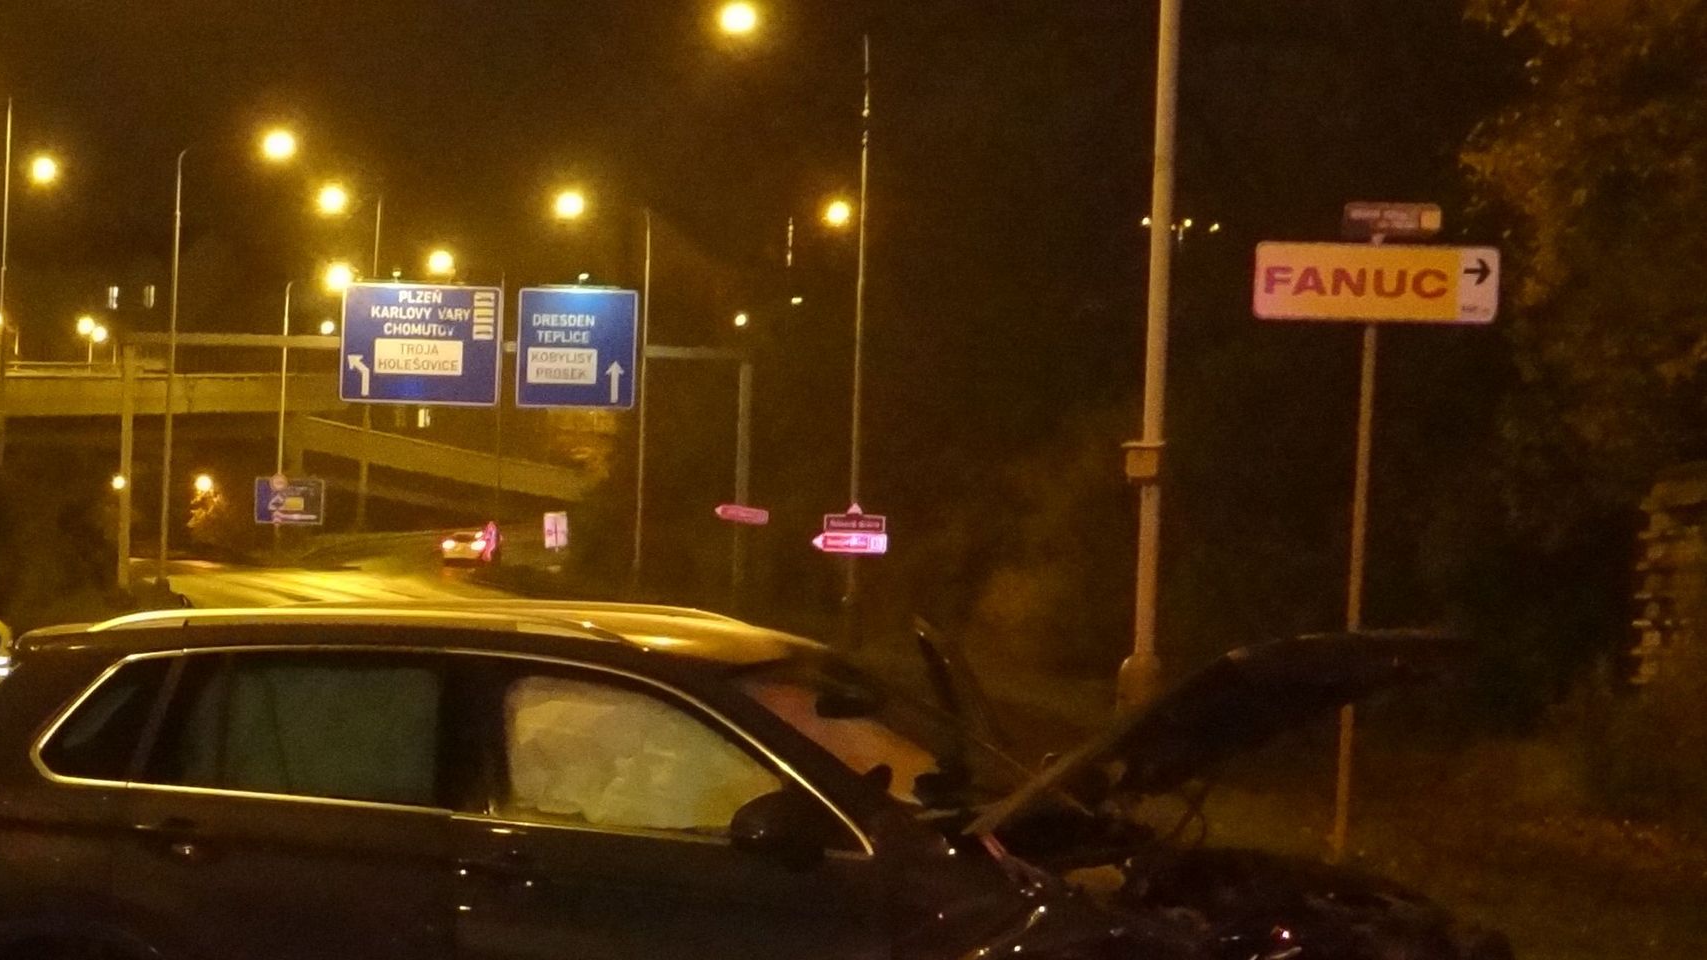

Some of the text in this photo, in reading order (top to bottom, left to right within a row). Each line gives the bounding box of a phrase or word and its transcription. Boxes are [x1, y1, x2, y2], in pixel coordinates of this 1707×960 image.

[1263, 266, 1449, 299] FANUC
[398, 289, 443, 304] PLZEŇ
[370, 306, 471, 321] KARLOVY VARY
[532, 313, 596, 328] DRESDEN
[383, 322, 456, 336] CHOMUTOV
[536, 330, 591, 344] TEPLICE
[400, 343, 439, 355] TROJA
[377, 357, 459, 372] HOLEŠOVICE
[530, 351, 594, 364] KOBYLISY
[535, 367, 587, 380] PROSEK
